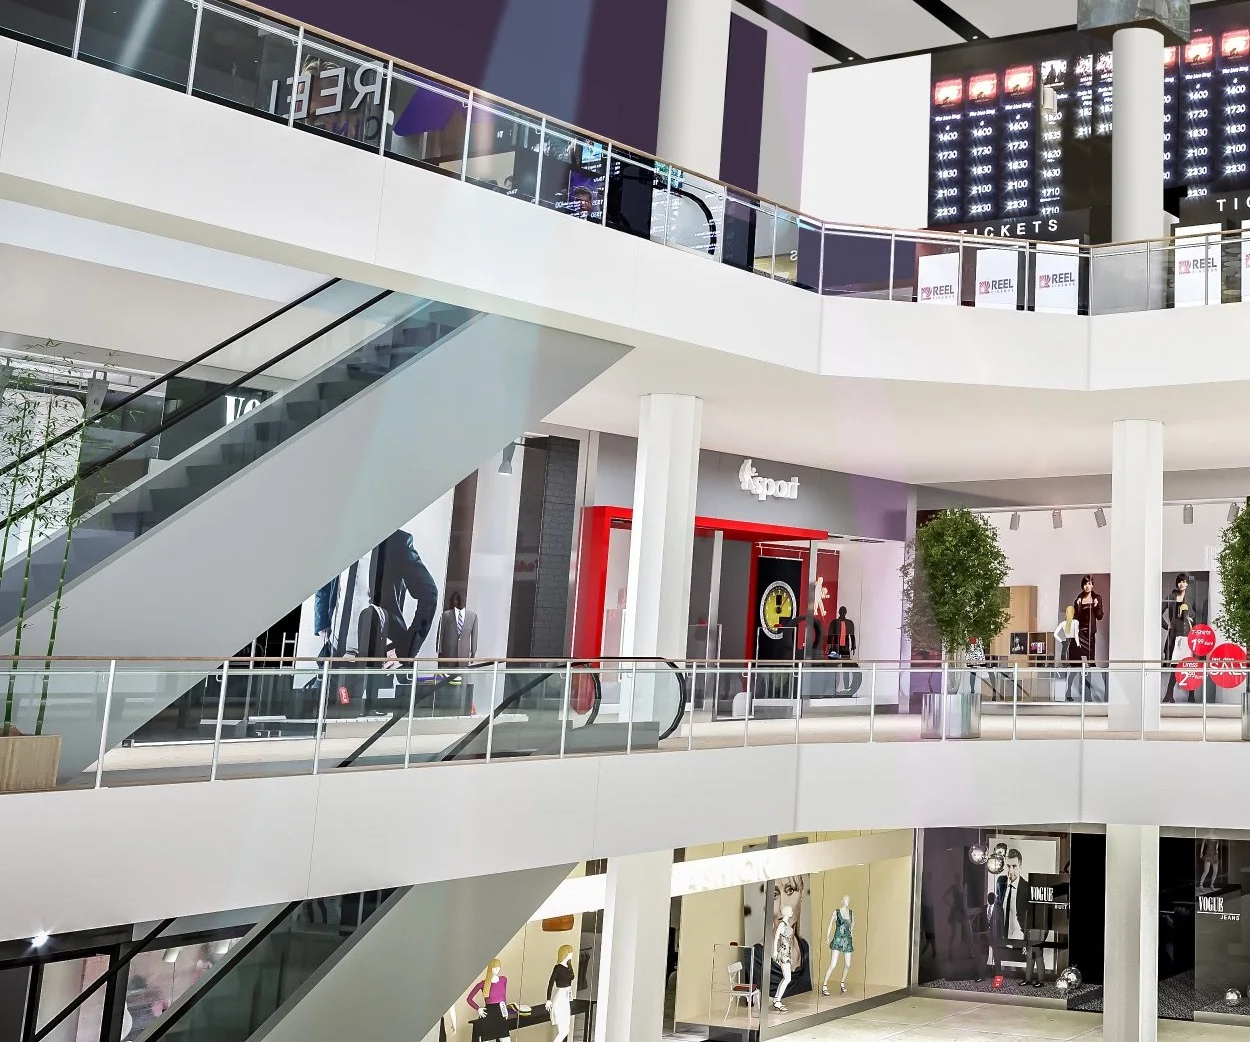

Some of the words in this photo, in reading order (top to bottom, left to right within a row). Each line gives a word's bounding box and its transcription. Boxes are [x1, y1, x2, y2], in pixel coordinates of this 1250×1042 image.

[1192, 258, 1217, 269] REEL
[991, 278, 1014, 290] REEL
[1051, 272, 1075, 284] REEL
[932, 284, 955, 296] REEL
[1031, 886, 1054, 901] VOGUE
[1199, 895, 1224, 912] VOGUE
